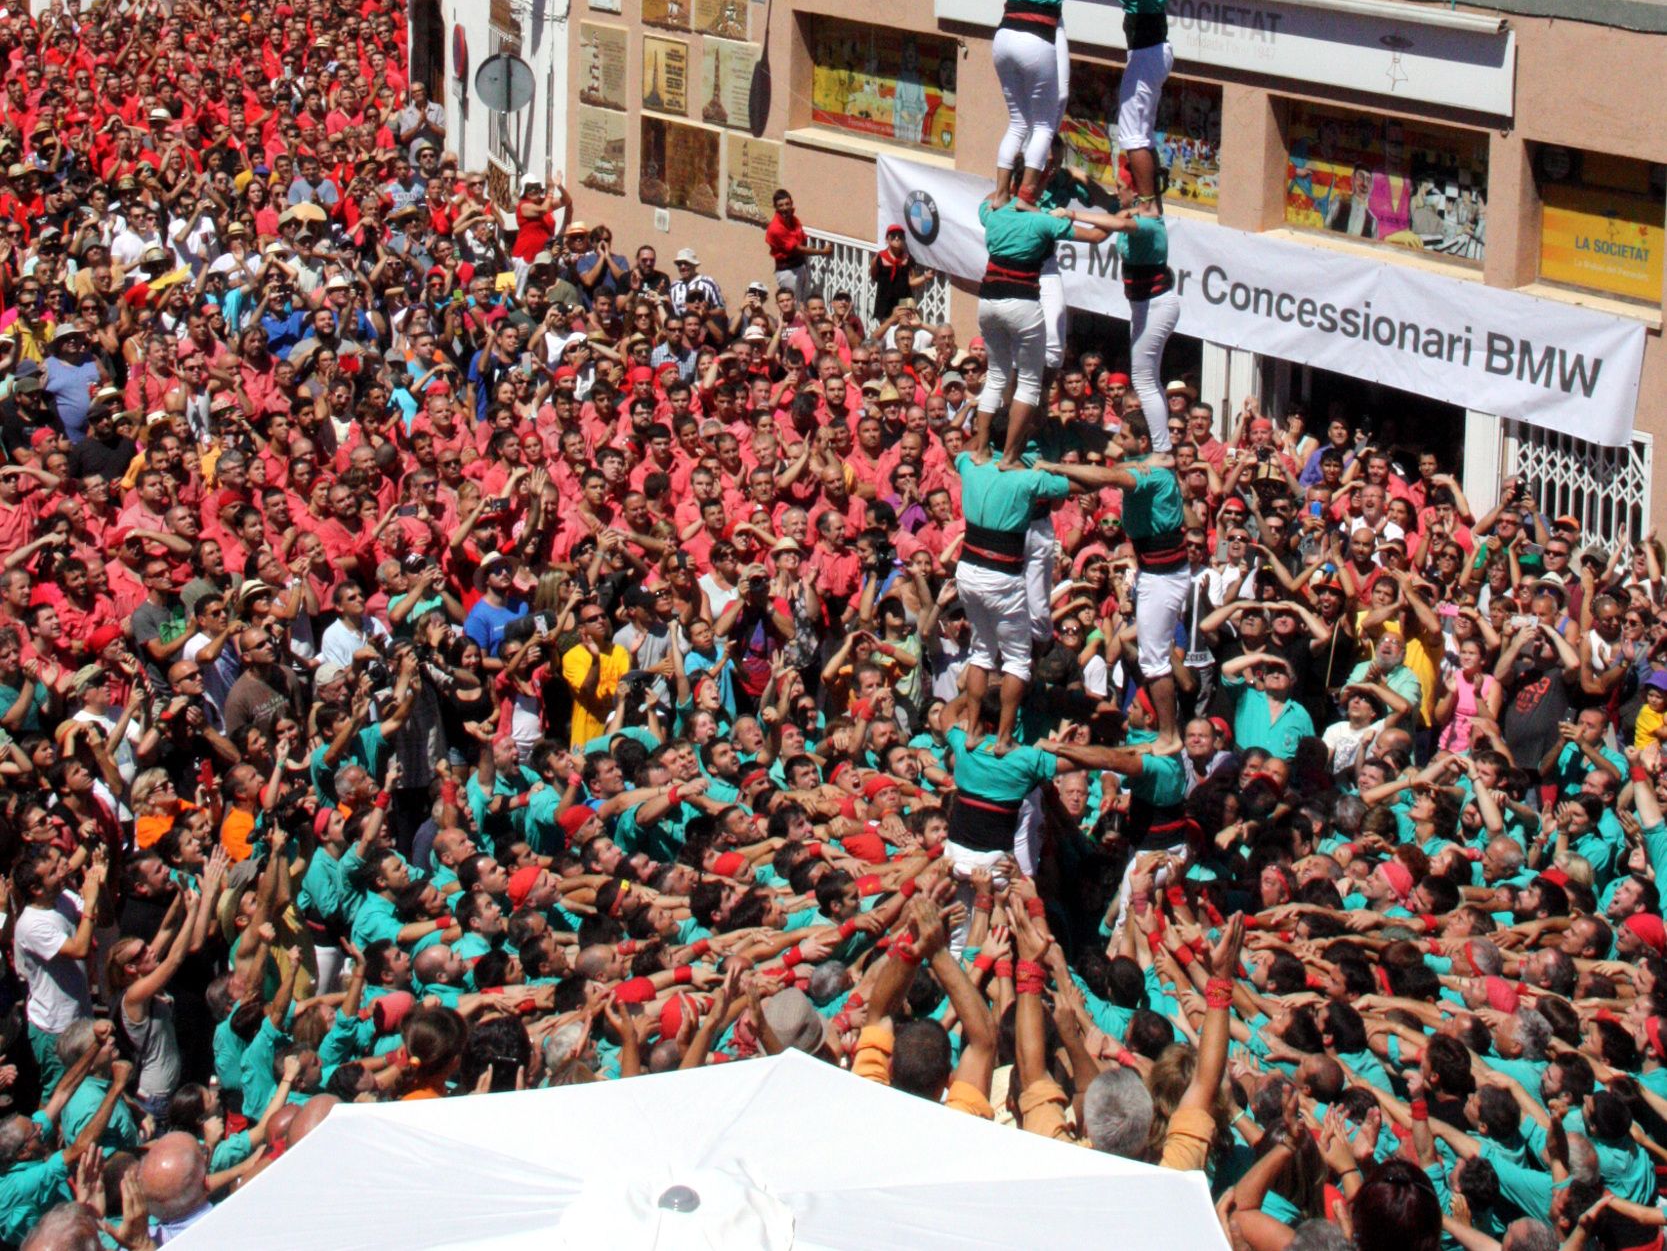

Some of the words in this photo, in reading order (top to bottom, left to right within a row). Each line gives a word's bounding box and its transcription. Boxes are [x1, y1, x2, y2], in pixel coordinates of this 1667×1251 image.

[1575, 237, 1590, 251] LA
[1593, 239, 1649, 262] SOCIETAT
[1201, 264, 1473, 368] Concessionari
[1484, 330, 1604, 399] BMW
